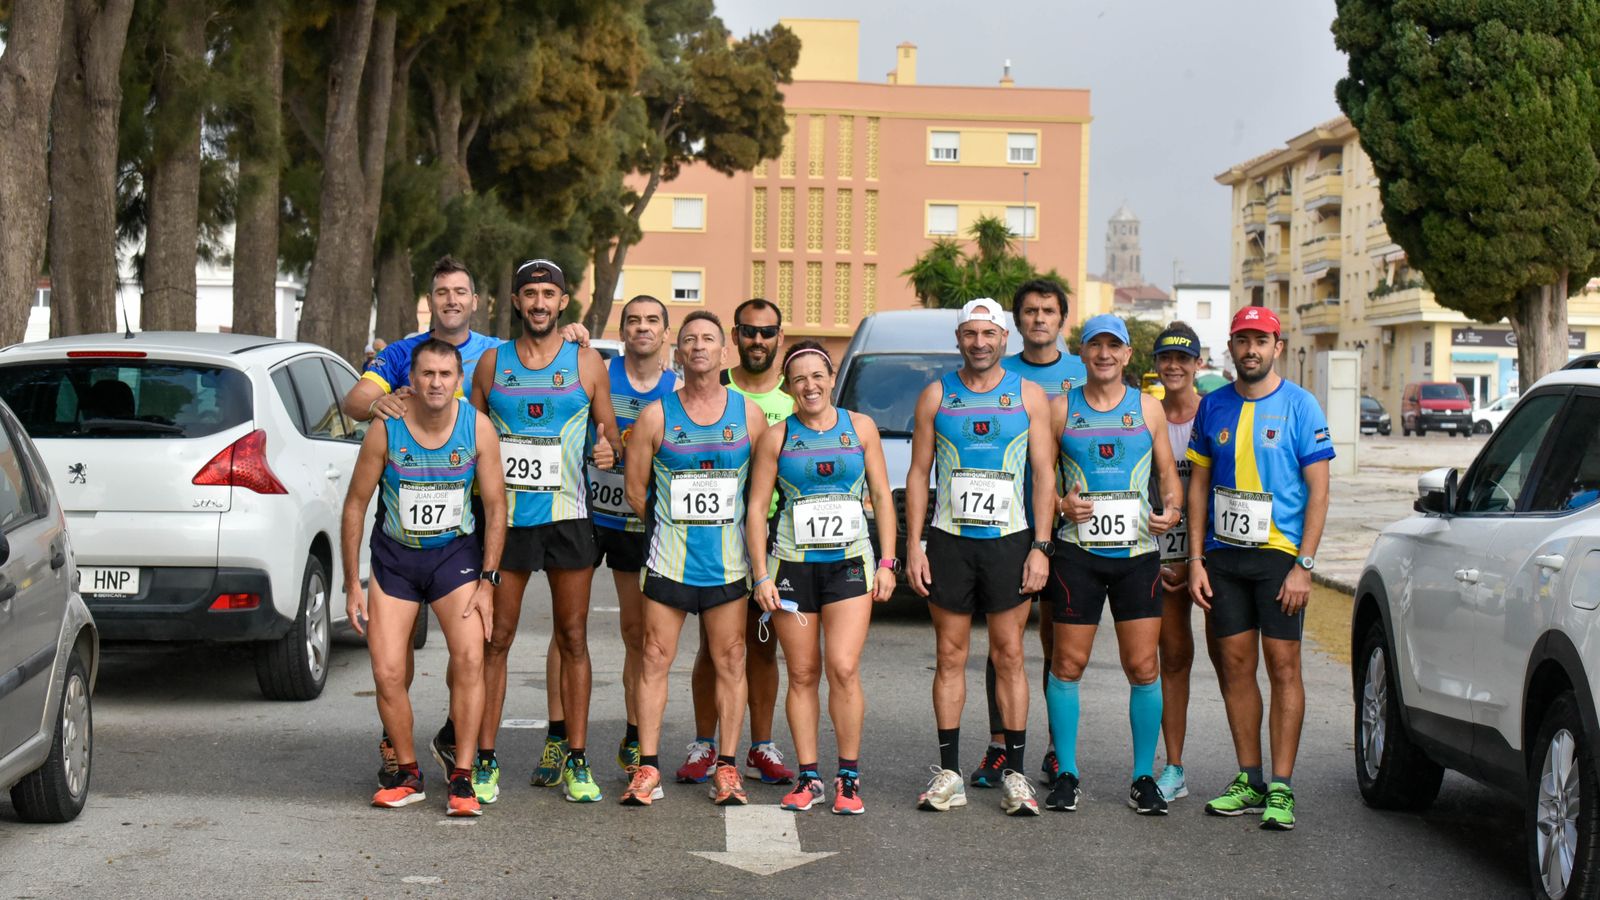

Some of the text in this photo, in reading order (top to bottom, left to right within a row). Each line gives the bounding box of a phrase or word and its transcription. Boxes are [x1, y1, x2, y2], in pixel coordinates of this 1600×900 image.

[764, 412, 782, 420] IFE
[506, 457, 542, 480] 293
[1176, 460, 1192, 468] IAT
[591, 481, 624, 507] 308
[683, 492, 720, 514] 163
[960, 491, 995, 514] 174
[409, 504, 446, 525] 187
[1088, 514, 1125, 536] 305
[1221, 510, 1250, 535] 173
[806, 515, 844, 537] 172
[1166, 532, 1187, 553] 27
[94, 570, 131, 590] HNP
